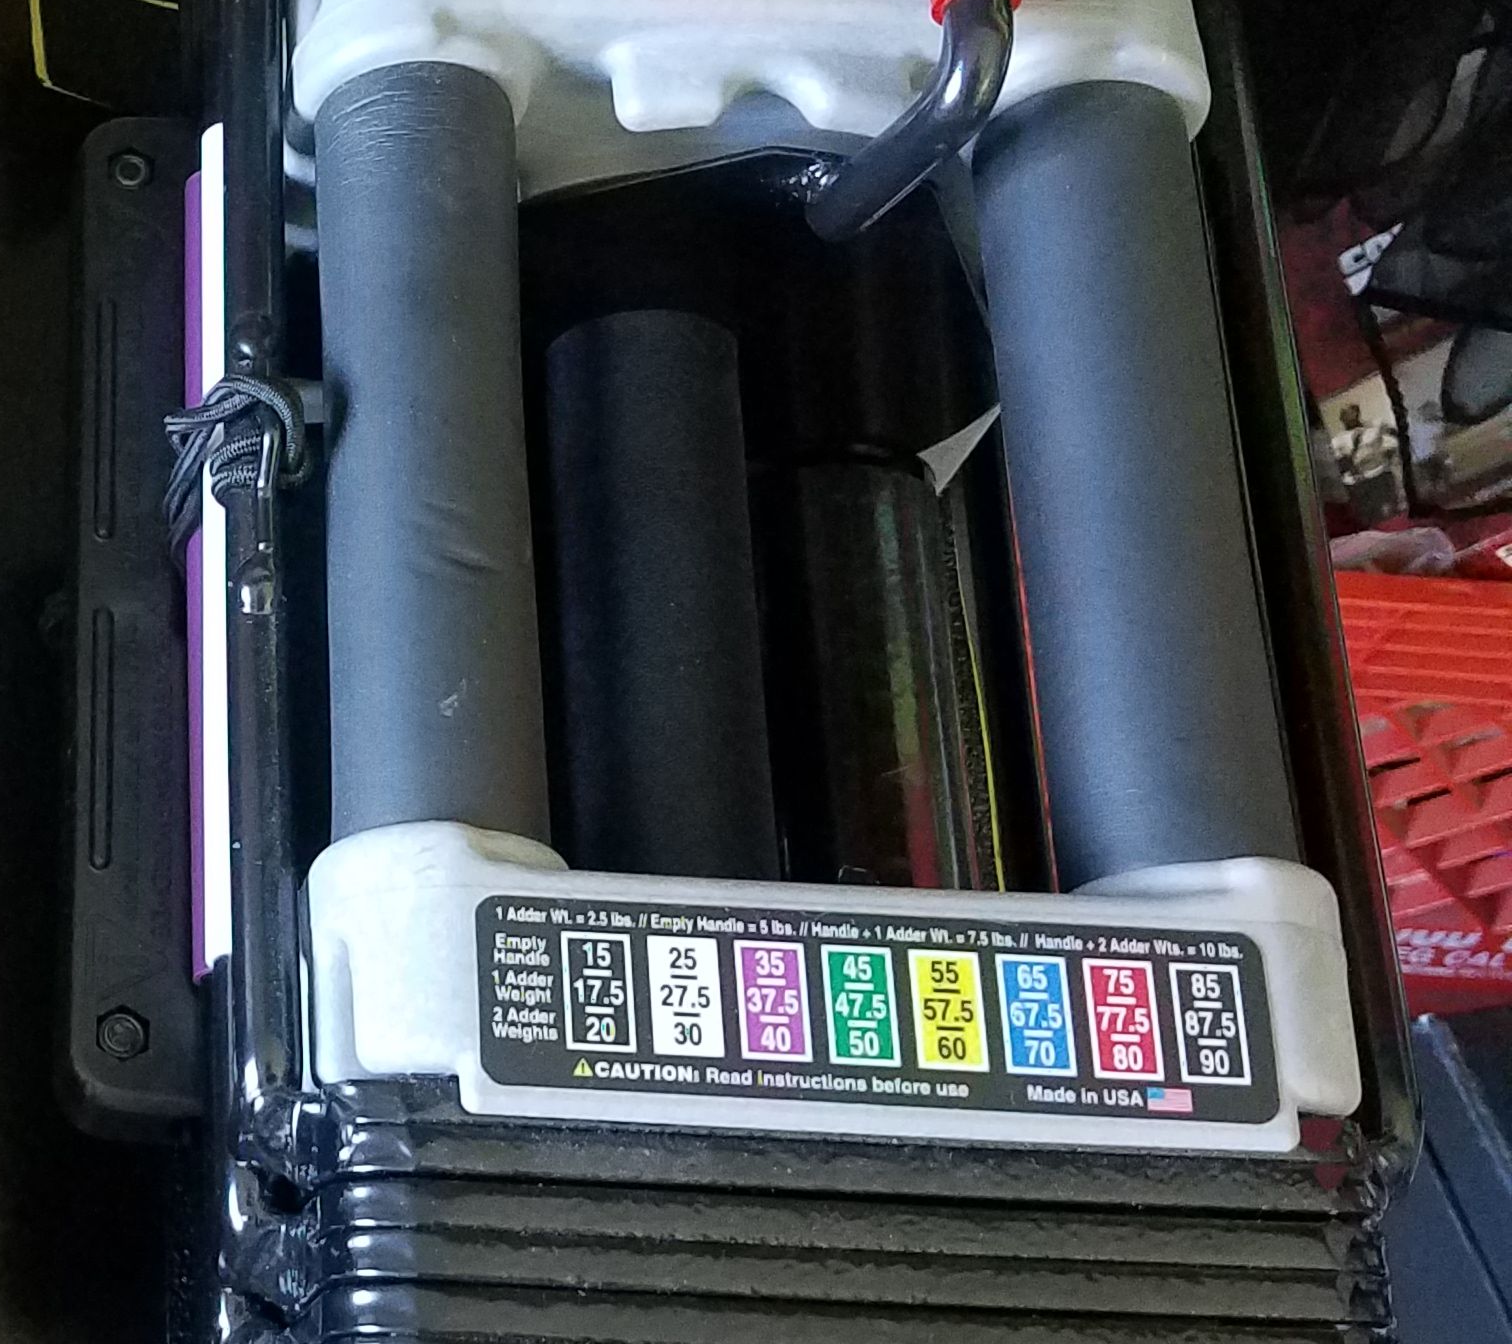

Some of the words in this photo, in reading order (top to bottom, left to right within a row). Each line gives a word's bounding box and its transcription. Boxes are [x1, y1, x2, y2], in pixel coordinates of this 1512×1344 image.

[495, 933, 546, 953] Empty
[496, 906, 503, 920] 1
[506, 908, 547, 923] Adder
[588, 911, 608, 926] 2.5
[611, 912, 636, 927] lbs.
[651, 913, 693, 933] Empty
[697, 916, 744, 933] Handle
[760, 920, 768, 933] 5
[772, 920, 796, 935] lbs.
[811, 922, 859, 939] Handle
[875, 926, 881, 939] 1
[886, 926, 927, 942] Adder
[967, 930, 988, 945] 7.5
[992, 931, 1017, 947] lbs.
[1035, 934, 1083, 951] Handle
[1098, 938, 1107, 951] 2
[1110, 938, 1151, 954] Adder
[1199, 942, 1215, 956] 10
[1218, 943, 1243, 959] lbs.
[493, 949, 550, 966] Handle
[582, 942, 612, 968] 15
[669, 947, 697, 970] 25
[755, 950, 785, 976] 35
[492, 970, 500, 984] 1
[504, 971, 554, 987] Adder
[842, 956, 872, 981] 45
[931, 961, 960, 984] 55
[1016, 964, 1049, 990] 65
[1102, 968, 1135, 995] 75
[495, 985, 552, 1006] Weight
[573, 978, 625, 1006] 17.5
[660, 985, 710, 1009] 27.5
[1191, 973, 1221, 998] 85
[746, 988, 799, 1015] 37.5
[835, 992, 887, 1020] 47.5
[923, 998, 974, 1023] 57.5
[493, 1007, 503, 1022] 2
[506, 1008, 556, 1024] Adder
[1010, 1002, 1062, 1029] 67.5
[1096, 1006, 1150, 1034] 77.5
[1184, 1010, 1236, 1037] 87.5
[492, 1023, 558, 1043] Weights
[585, 1016, 617, 1043] 20
[673, 1022, 702, 1046] 30
[760, 1026, 791, 1052] 40
[848, 1030, 880, 1056] 50
[938, 1036, 966, 1060] 60
[1024, 1040, 1056, 1066] 70
[1112, 1045, 1144, 1071] 80
[1200, 1049, 1230, 1074] 90
[595, 1060, 699, 1083] CAUTION:
[706, 1067, 753, 1085] Read
[757, 1070, 867, 1092] instructions
[872, 1076, 931, 1095] before
[936, 1083, 970, 1097] use
[1027, 1084, 1076, 1103] Made
[1081, 1088, 1098, 1104] in
[1104, 1089, 1144, 1107] USA
